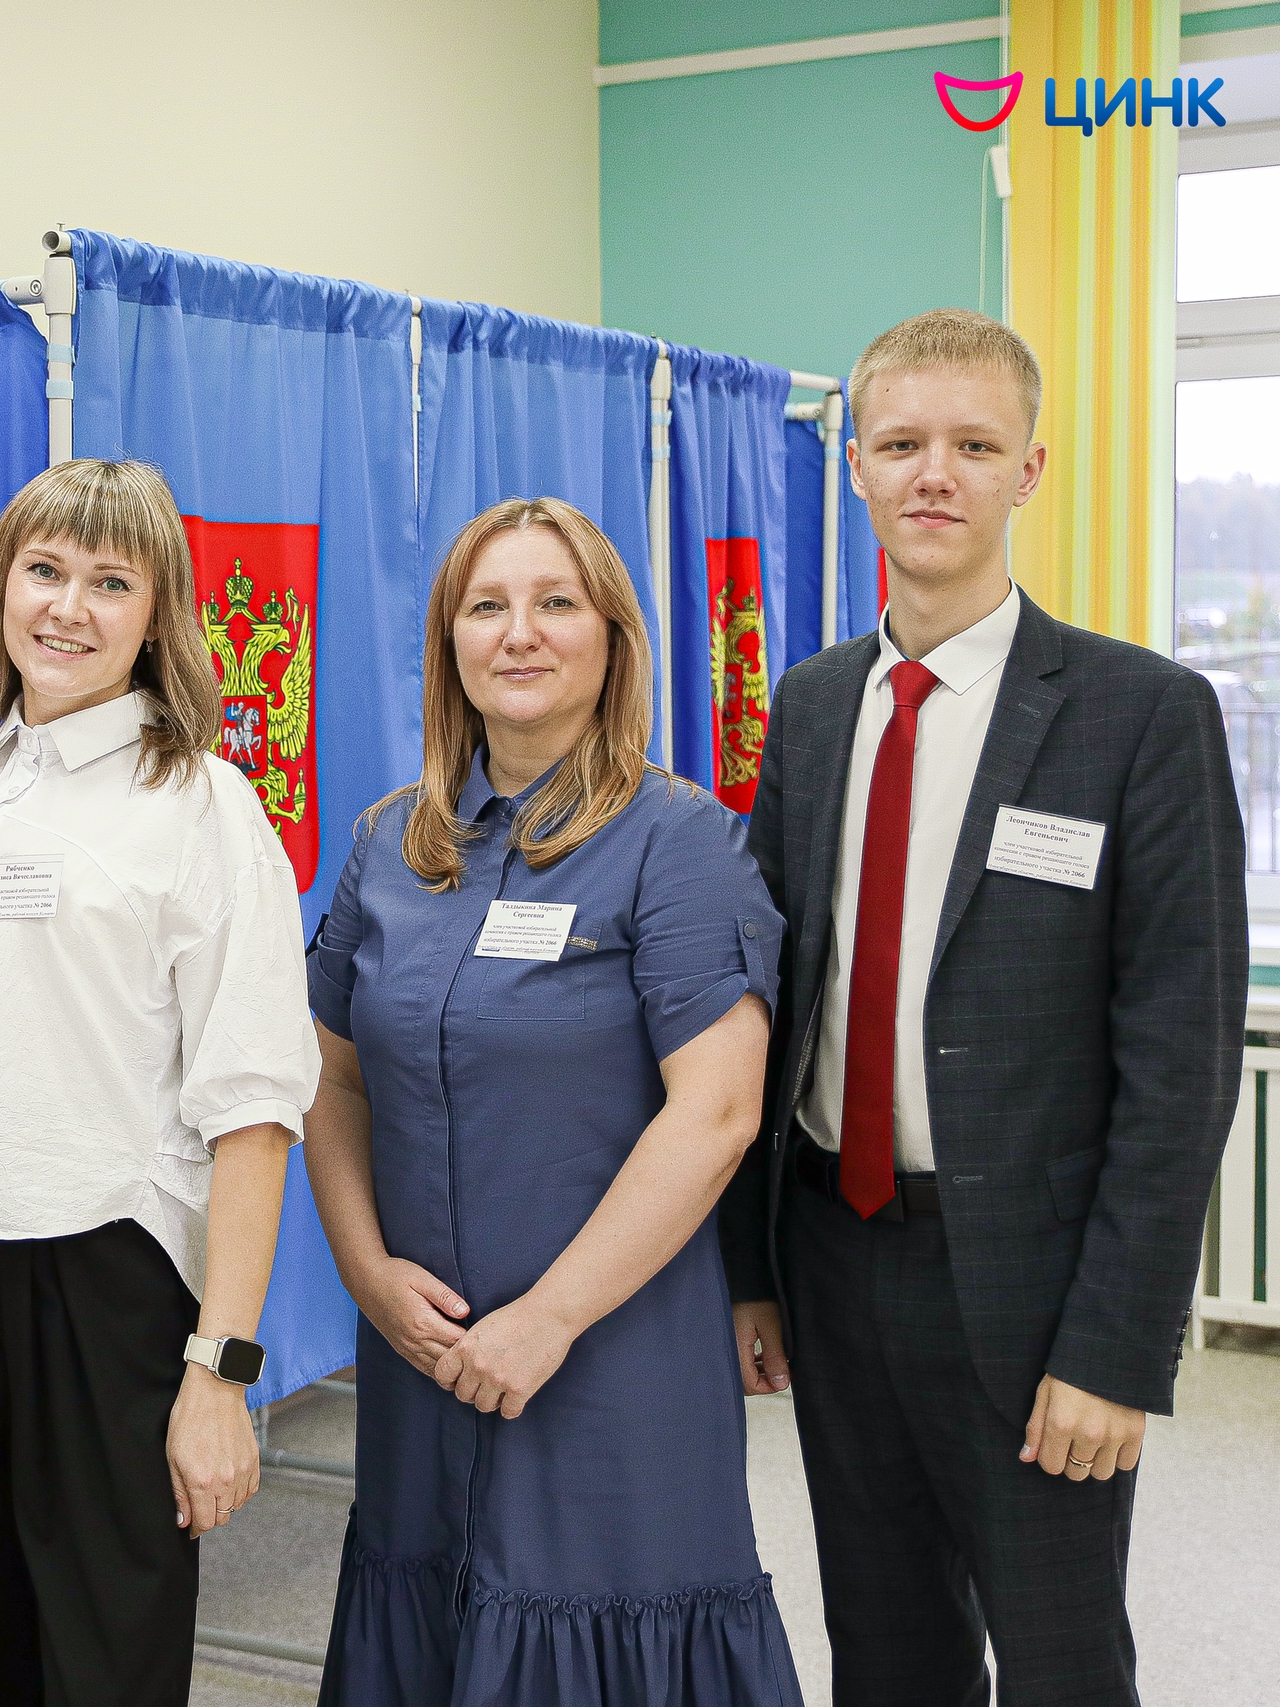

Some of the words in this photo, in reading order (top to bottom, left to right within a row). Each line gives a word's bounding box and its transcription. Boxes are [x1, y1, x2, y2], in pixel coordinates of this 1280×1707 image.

[1006, 816, 1048, 829] Леончиков
[1050, 824, 1090, 837] Владислав
[1024, 828, 1068, 843] Евгеньевич
[1039, 865, 1062, 873] участка
